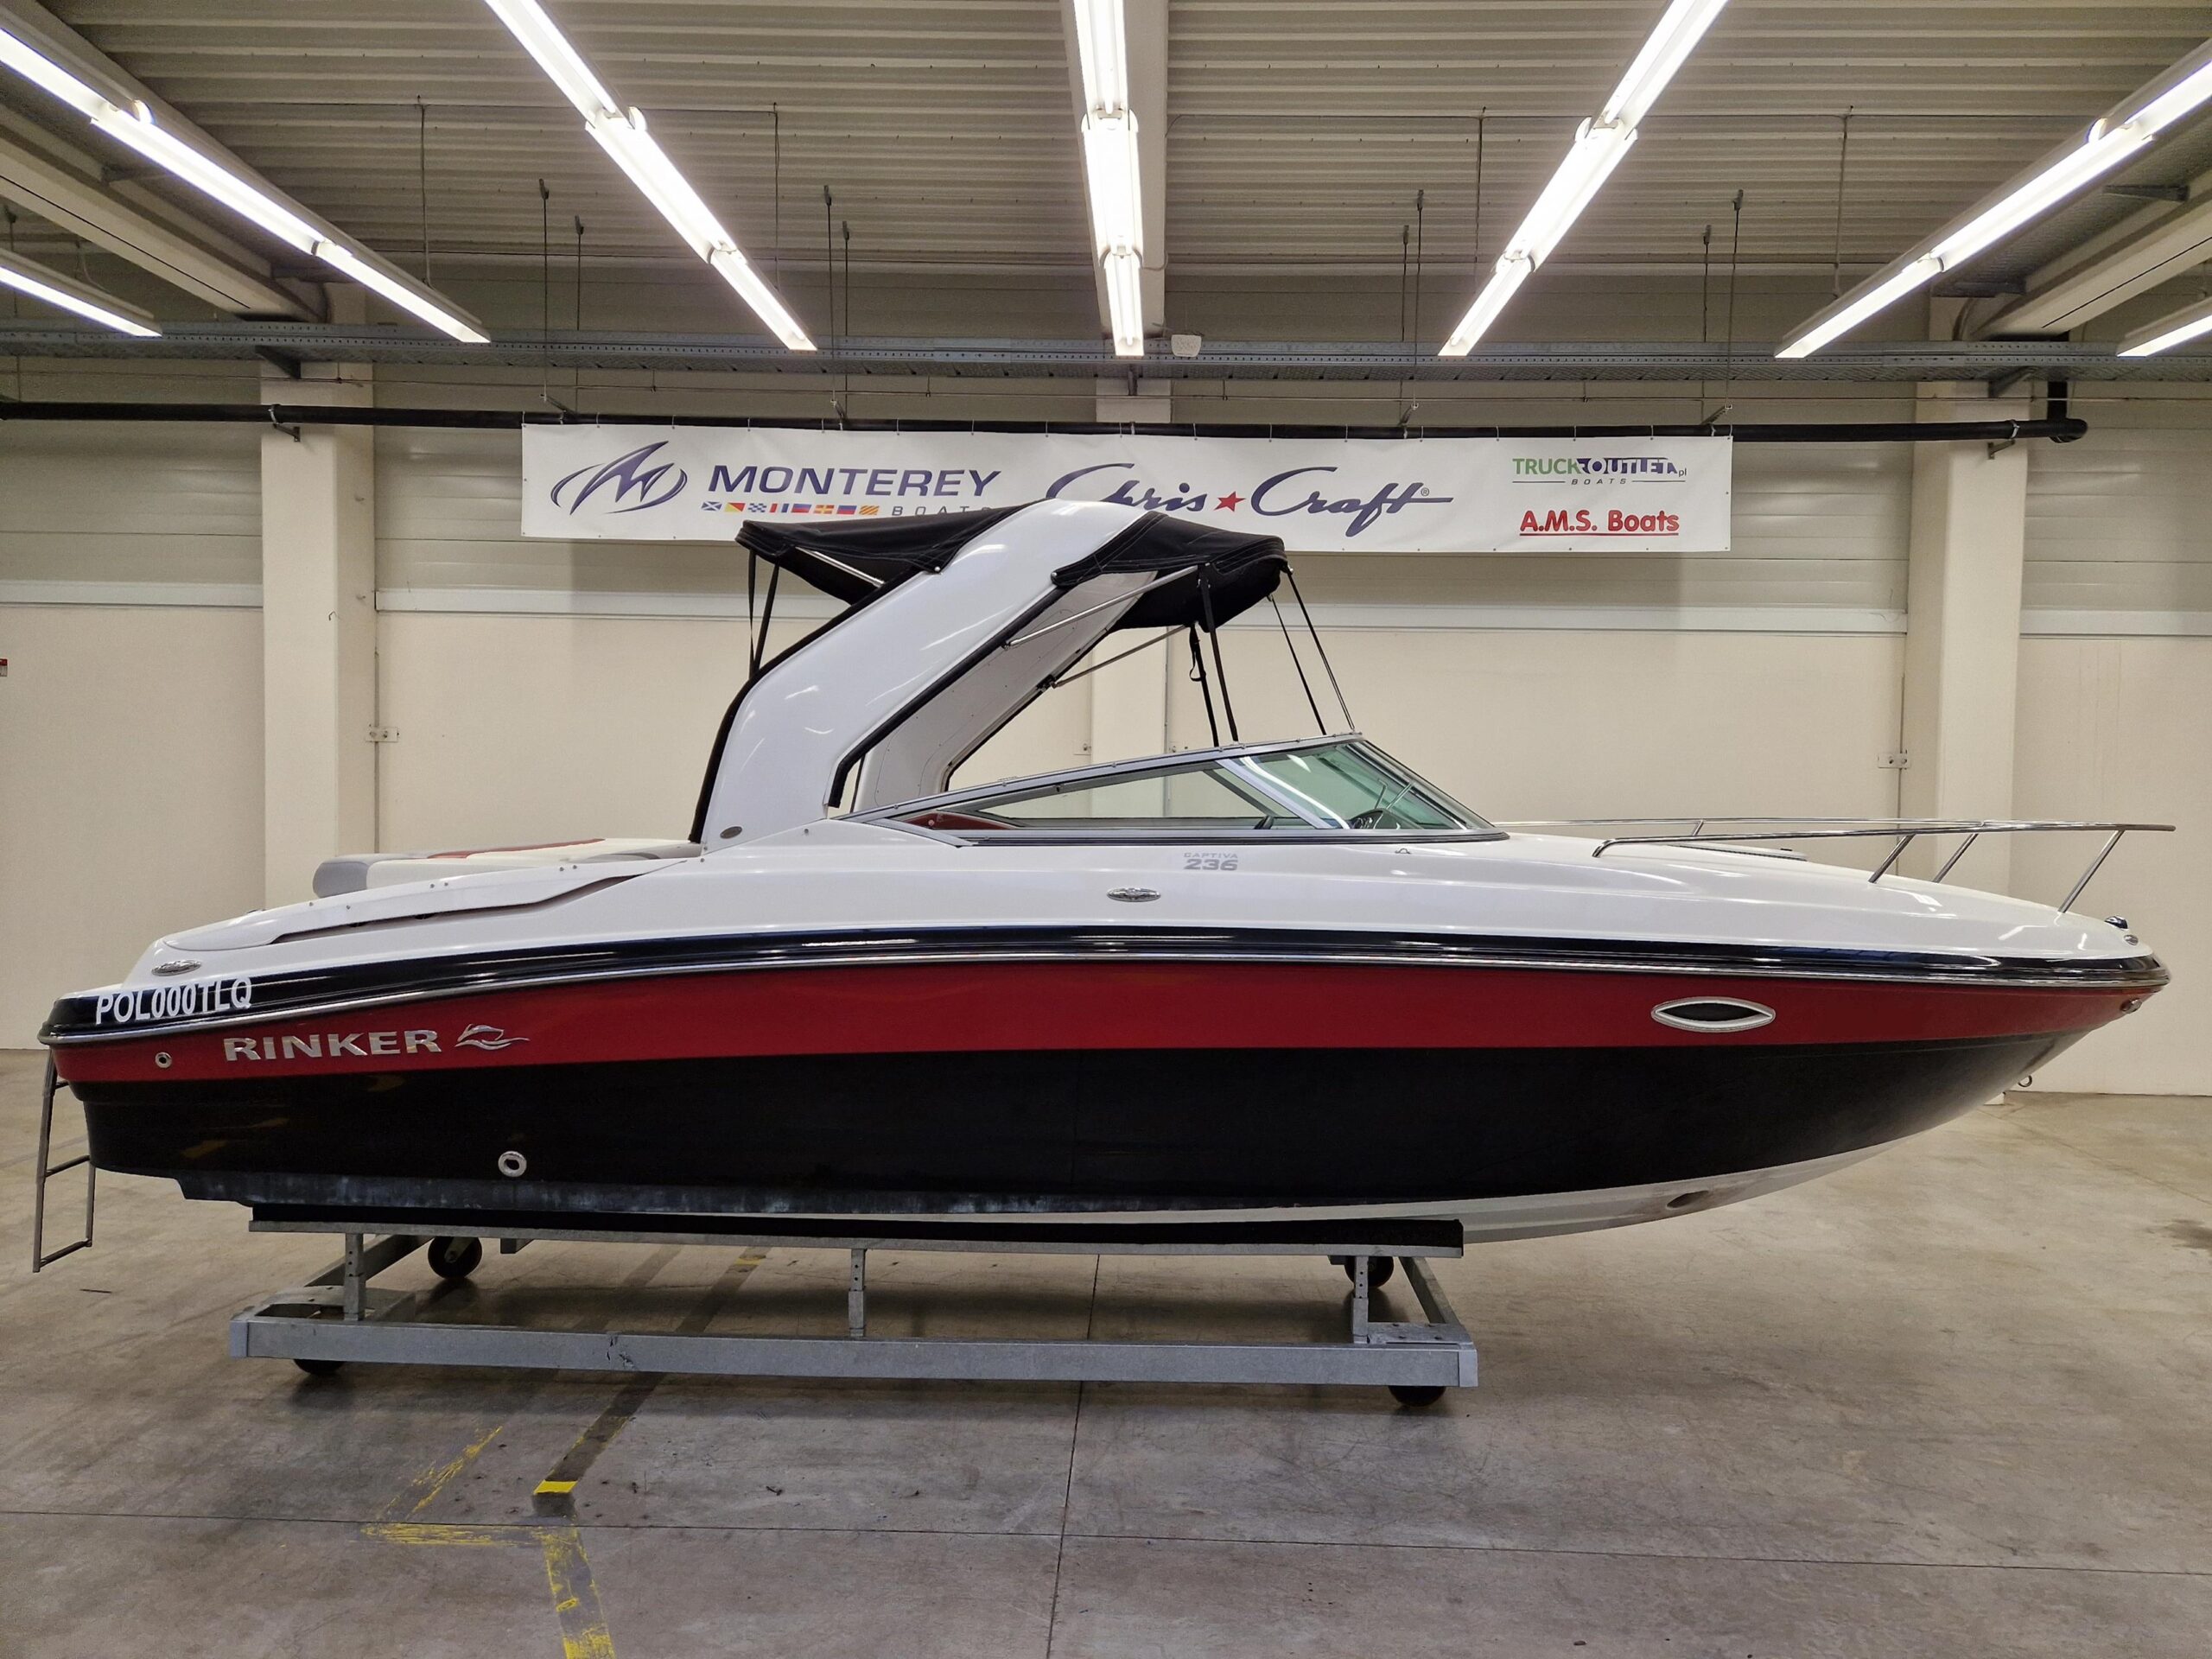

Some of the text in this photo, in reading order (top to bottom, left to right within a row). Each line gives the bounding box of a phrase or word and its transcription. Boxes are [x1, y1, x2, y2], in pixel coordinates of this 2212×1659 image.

[709, 465, 1001, 497] MONTEREY
[1520, 510, 1680, 532] A.M.S. Boats
[1184, 859, 1238, 871] 236
[223, 1030, 442, 1061] RINKER
